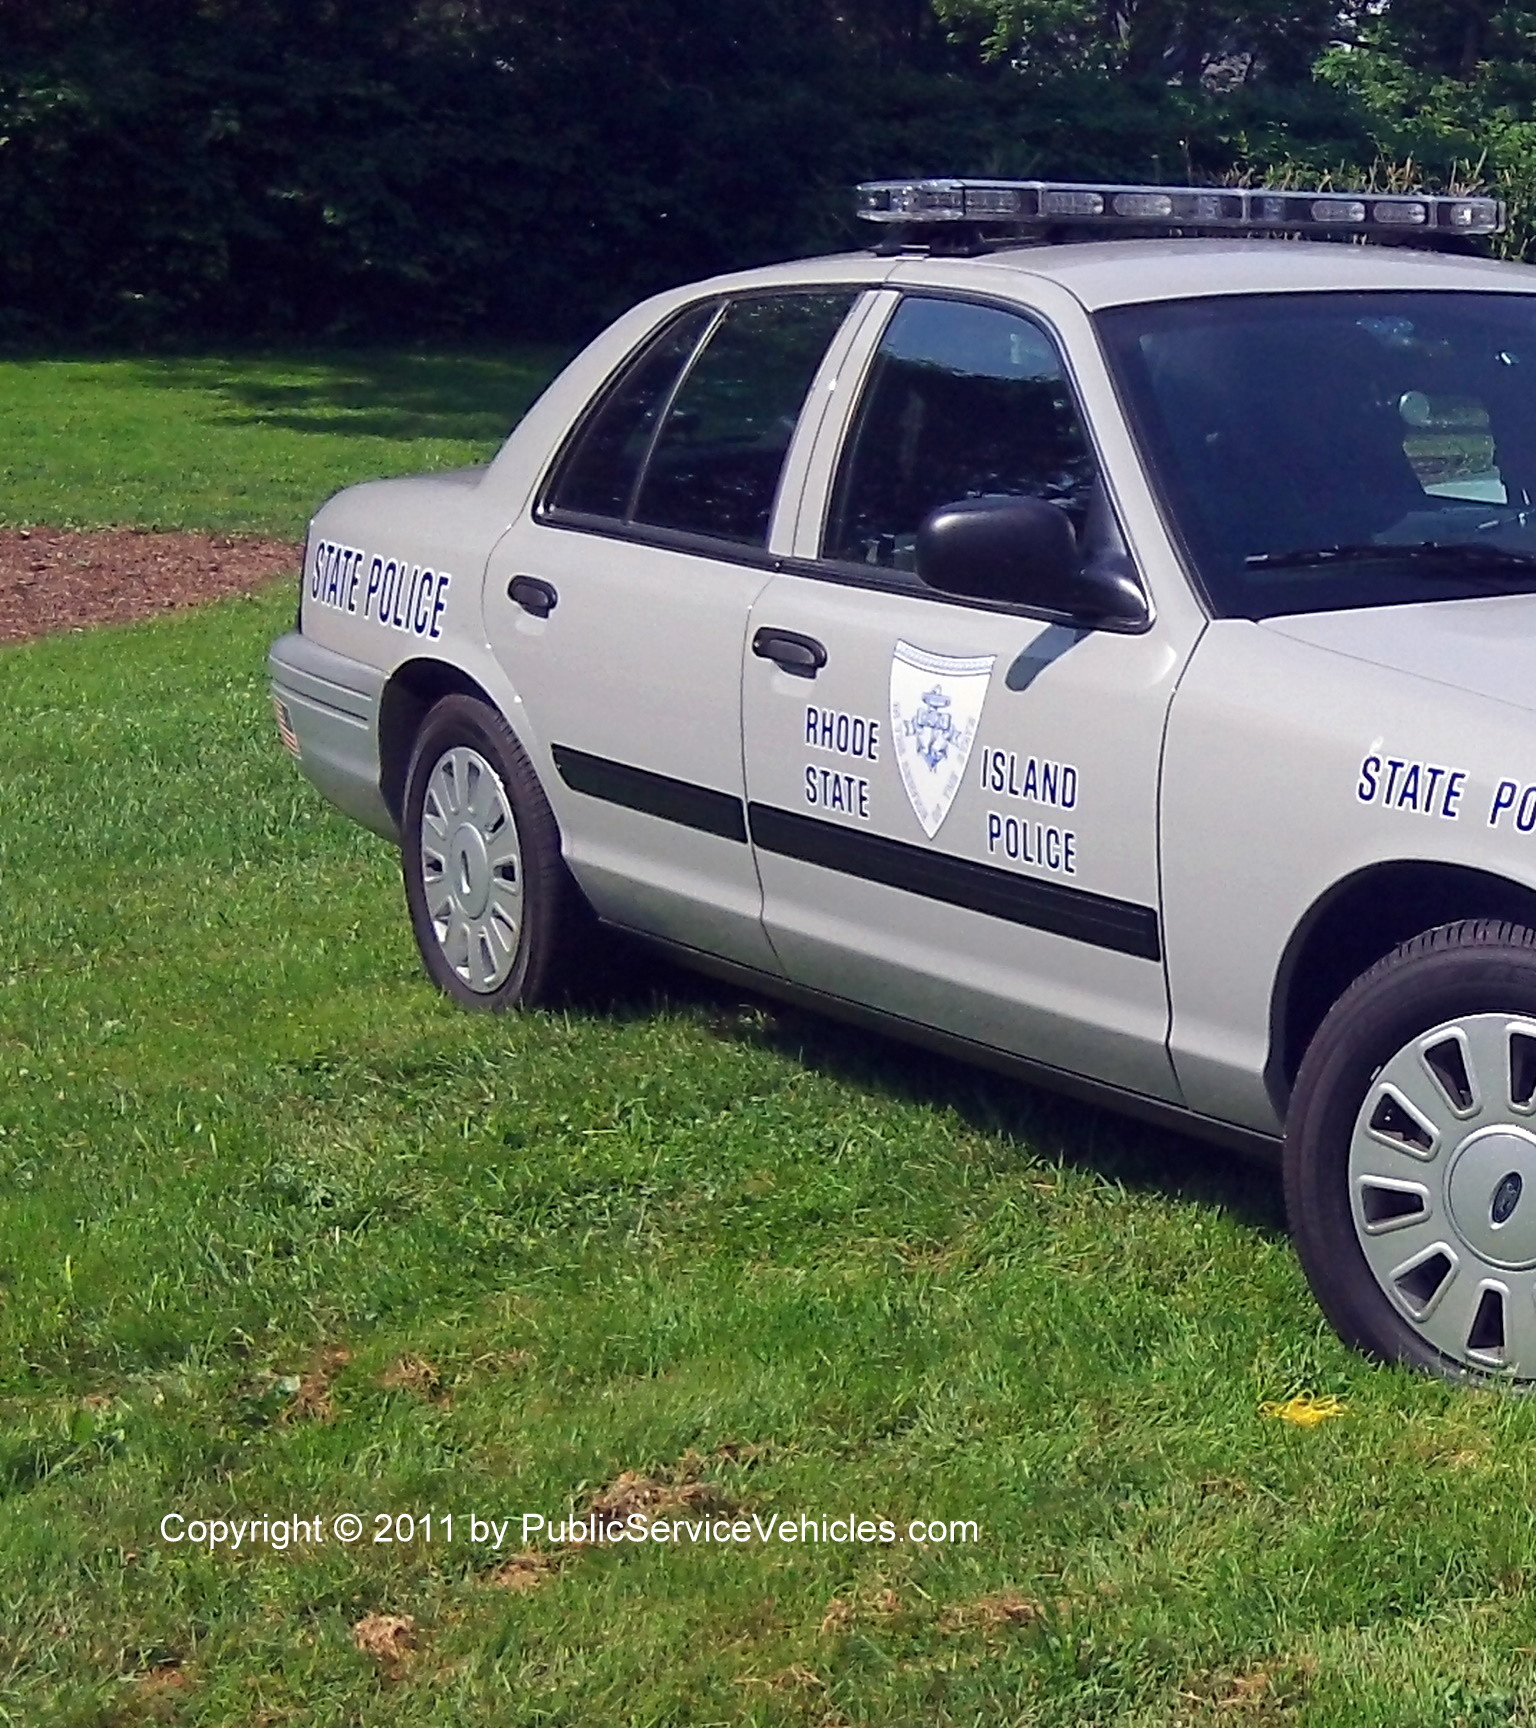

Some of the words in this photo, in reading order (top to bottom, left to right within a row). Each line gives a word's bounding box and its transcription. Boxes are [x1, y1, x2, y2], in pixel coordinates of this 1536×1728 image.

[311, 541, 365, 614] STATE
[364, 556, 450, 640] POLICE
[804, 705, 880, 762] RHODE
[979, 746, 1079, 811] ISLAND
[1356, 754, 1468, 819] STATE
[804, 765, 872, 819] STATE
[986, 811, 1078, 875] POLICE
